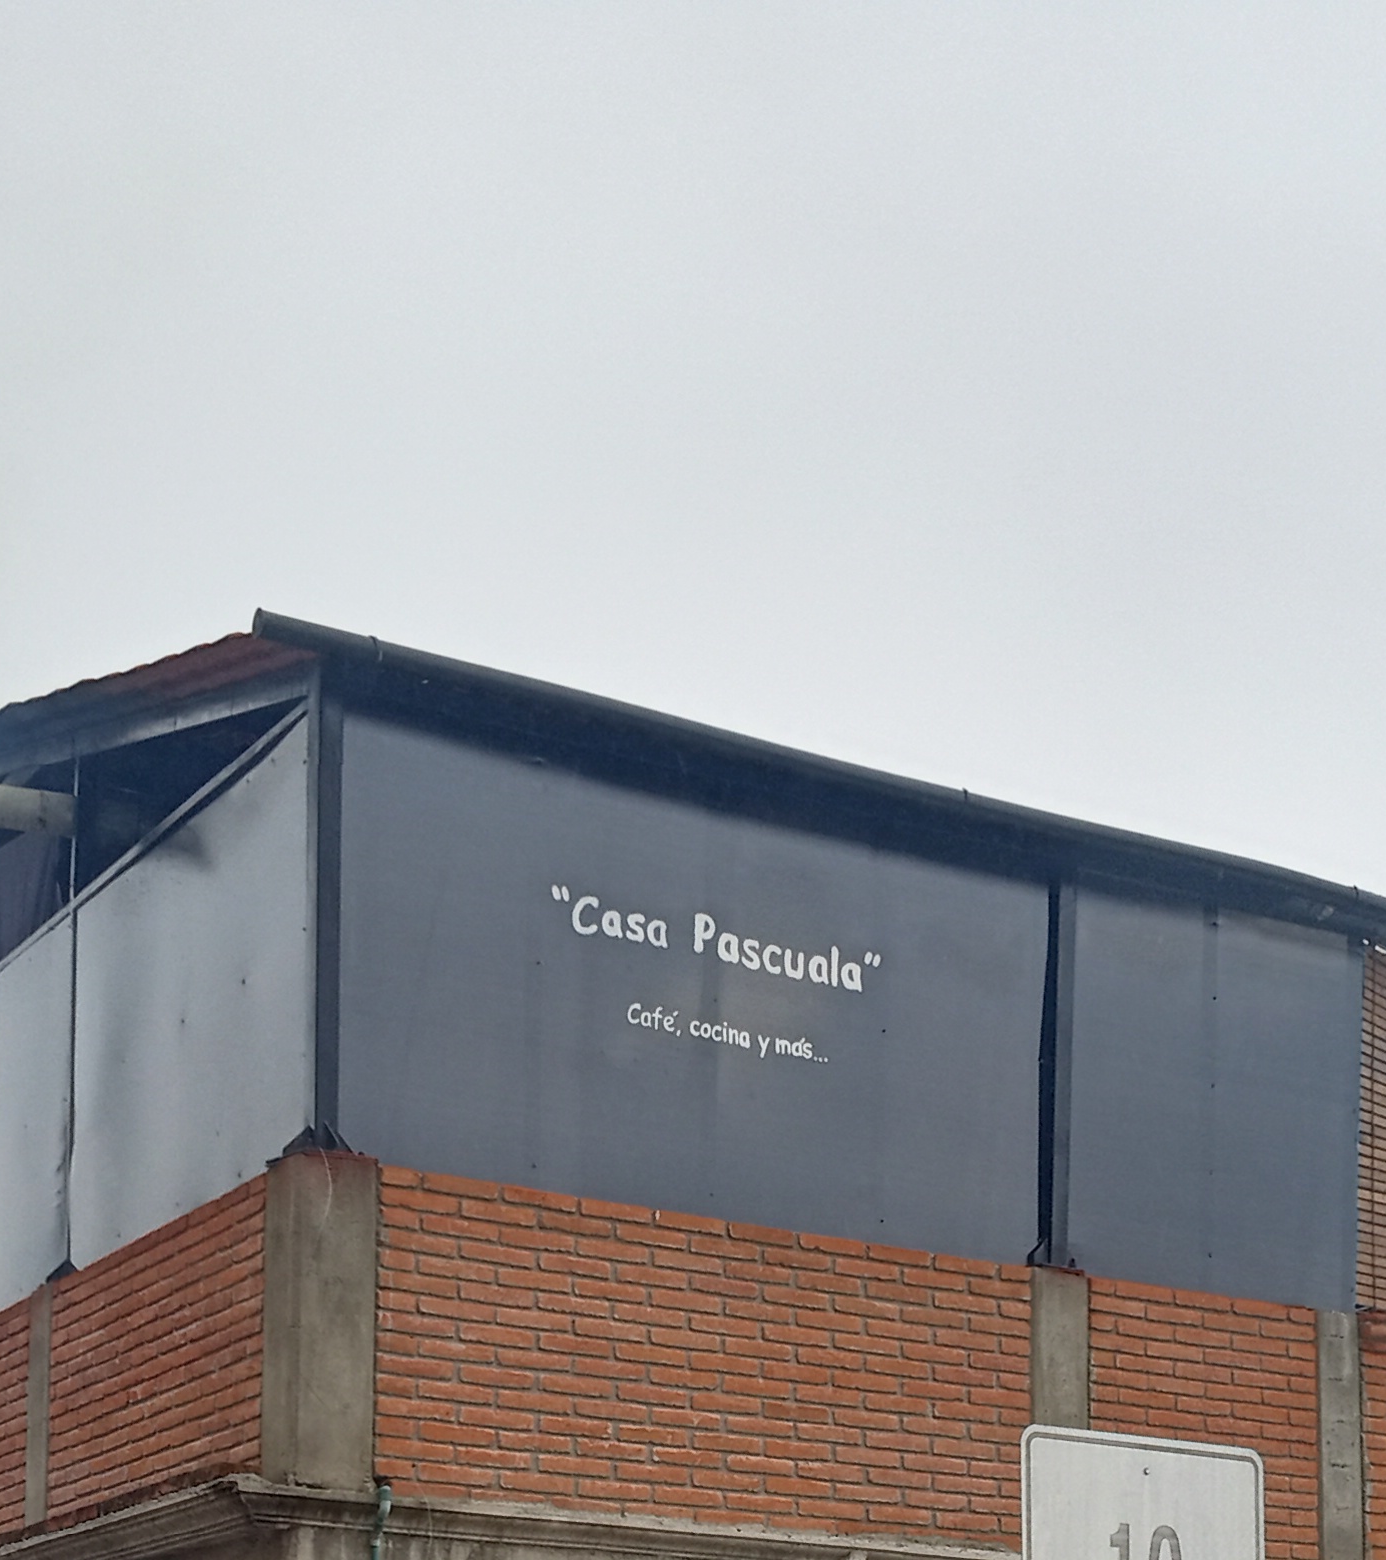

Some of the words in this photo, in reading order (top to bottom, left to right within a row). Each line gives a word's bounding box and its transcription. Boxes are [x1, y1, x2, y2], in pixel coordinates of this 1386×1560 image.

[551, 884, 668, 949] "Casa
[693, 912, 882, 993] Pascuala"
[627, 1002, 682, 1037] Café,
[689, 1019, 750, 1049] cocina
[757, 1034, 770, 1058] y
[775, 1037, 829, 1063] más...
